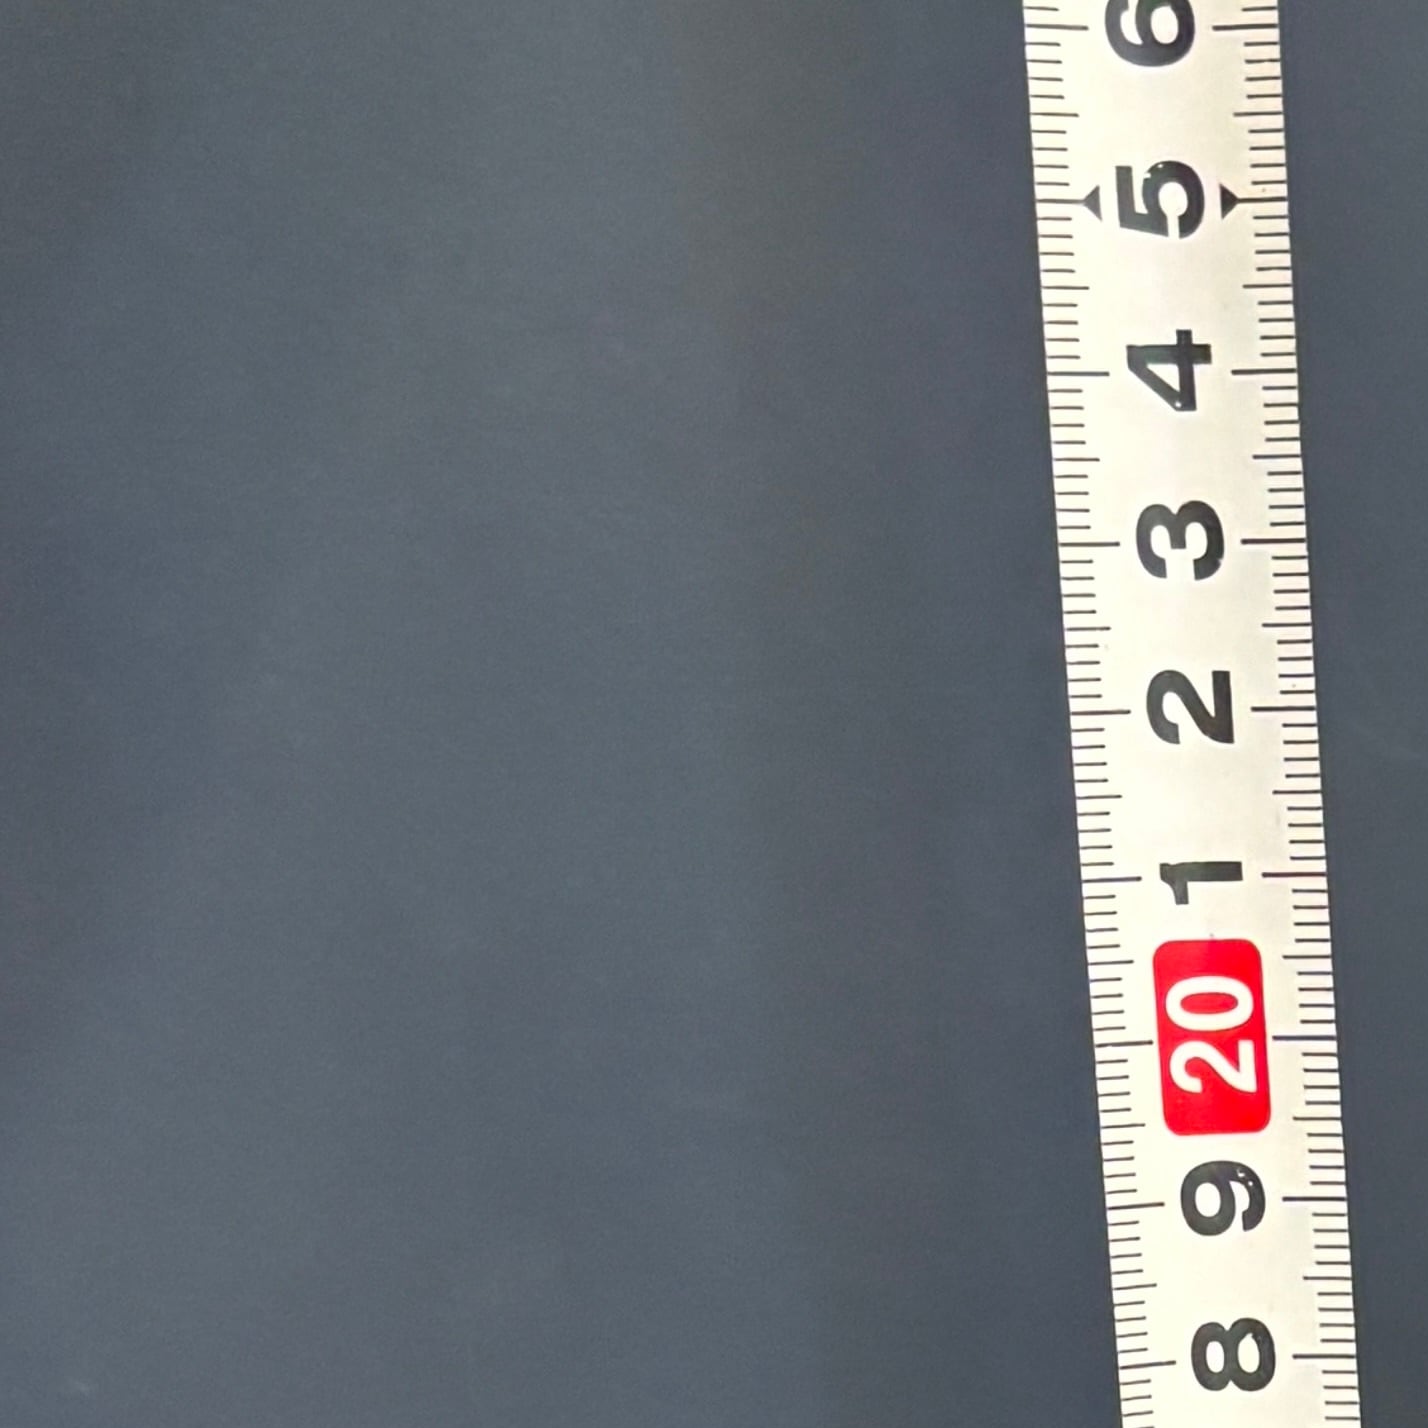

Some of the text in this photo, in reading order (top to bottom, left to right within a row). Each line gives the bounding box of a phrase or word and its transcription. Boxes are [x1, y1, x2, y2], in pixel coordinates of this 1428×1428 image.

[1104, 0, 1195, 67] 6
[1115, 160, 1205, 239] 5
[1126, 329, 1212, 411] 4
[1136, 500, 1225, 581] 3
[1146, 670, 1234, 744] 2
[1159, 861, 1243, 905] 1
[1165, 975, 1257, 1094] 20
[1180, 1160, 1266, 1236] 9
[1191, 1317, 1276, 1392] 8
